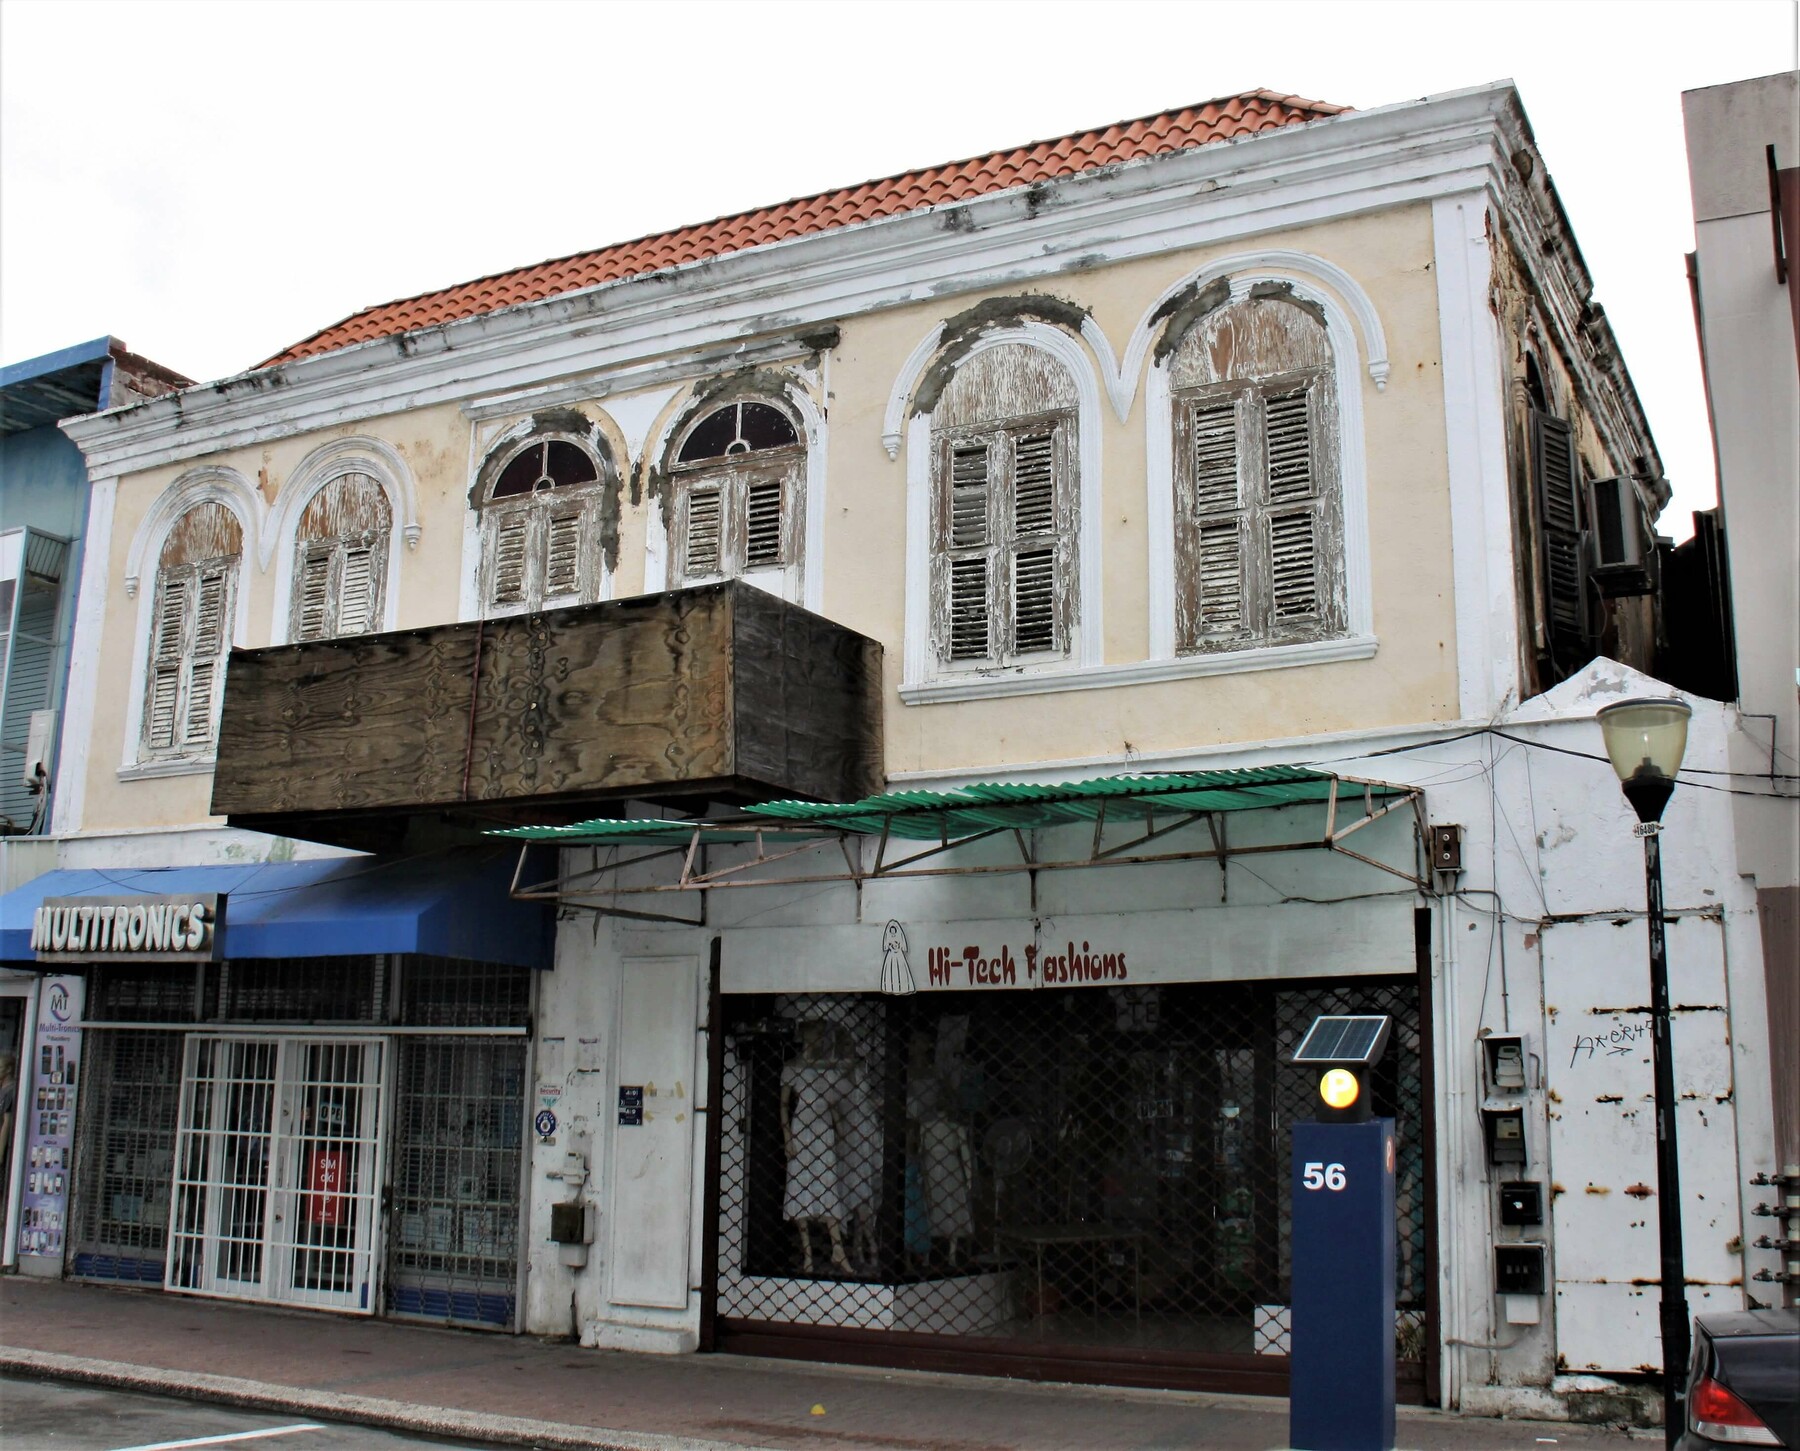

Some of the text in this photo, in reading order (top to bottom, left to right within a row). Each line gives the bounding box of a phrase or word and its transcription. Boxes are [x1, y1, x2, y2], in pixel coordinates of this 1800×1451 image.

[30, 903, 204, 951] MULTITRONICS
[928, 941, 1128, 986] Hi-Tech Fashions
[1302, 1162, 1347, 1191] 56
